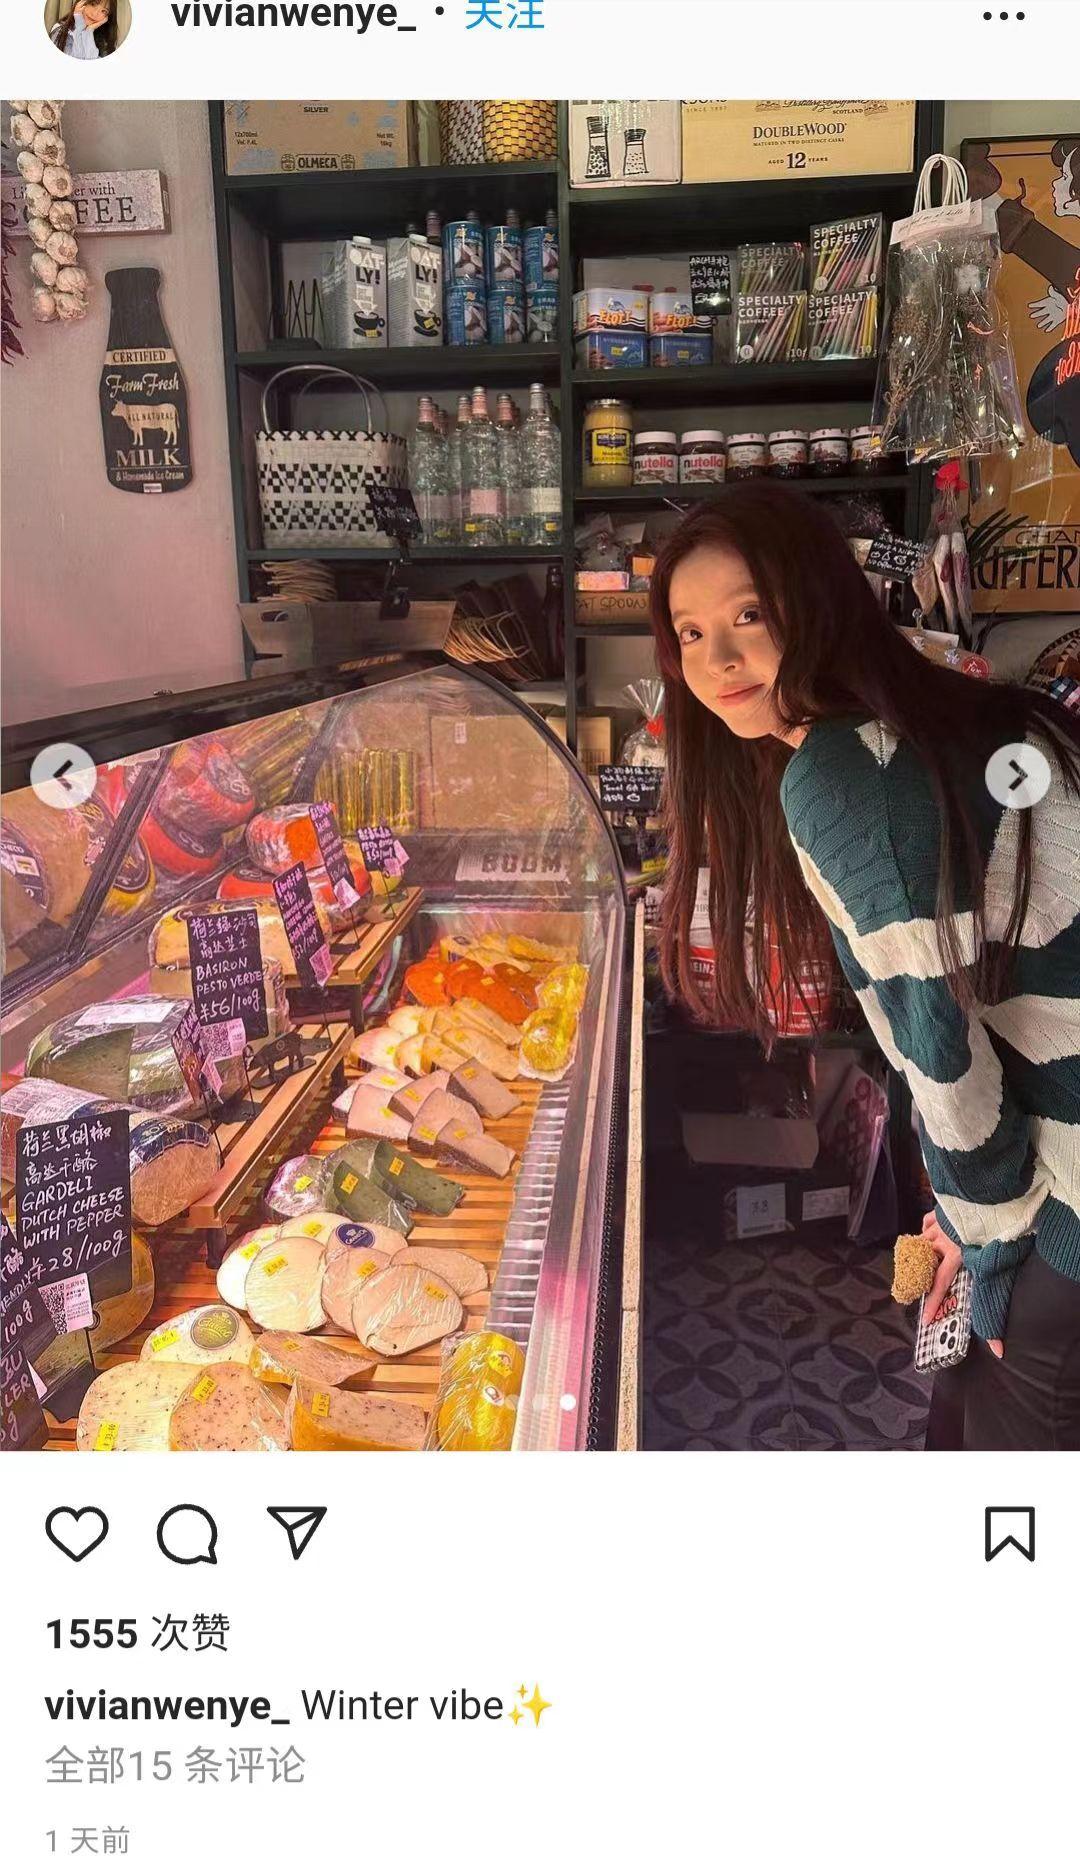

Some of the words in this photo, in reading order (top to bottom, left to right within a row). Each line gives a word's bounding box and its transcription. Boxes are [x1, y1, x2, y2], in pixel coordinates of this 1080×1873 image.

[298, 157, 338, 169] OLMECA
[787, 152, 806, 169] 12
[90, 182, 116, 196] with
[813, 217, 877, 239] SPECIALTY
[813, 233, 860, 250] COFFEE
[356, 266, 380, 285] LY!
[415, 264, 438, 284] LY!
[738, 294, 802, 307] SPECIALTY
[808, 290, 873, 309] SPECIALTY
[738, 307, 785, 318] COFFEE
[808, 304, 853, 319] COFFEE
[112, 350, 166, 363] CERTIFIED
[106, 375, 143, 398] Farm
[142, 371, 179, 397] Fresh
[128, 414, 140, 422] ALL
[141, 413, 174, 421] NATURAL
[116, 448, 181, 467] MILK
[634, 454, 674, 469] nutella
[683, 454, 724, 468] nutella
[116, 473, 121, 482] &
[122, 471, 155, 481] Homemade
[155, 470, 164, 480] Ice
[165, 470, 184, 480] Cream
[196, 957, 248, 982] BASIRON
[196, 979, 228, 998] PESTO
[230, 971, 262, 989] VERDE
[23, 1120, 111, 1157] 荷兰黑胡椒
[25, 1150, 98, 1187] 高达干酪
[21, 1175, 93, 1212] GARDELI
[21, 1203, 67, 1232] DUTCH
[73, 1187, 125, 1214] CHEESE
[24, 1224, 61, 1249] WITH
[67, 1204, 124, 1236] PEPPER
